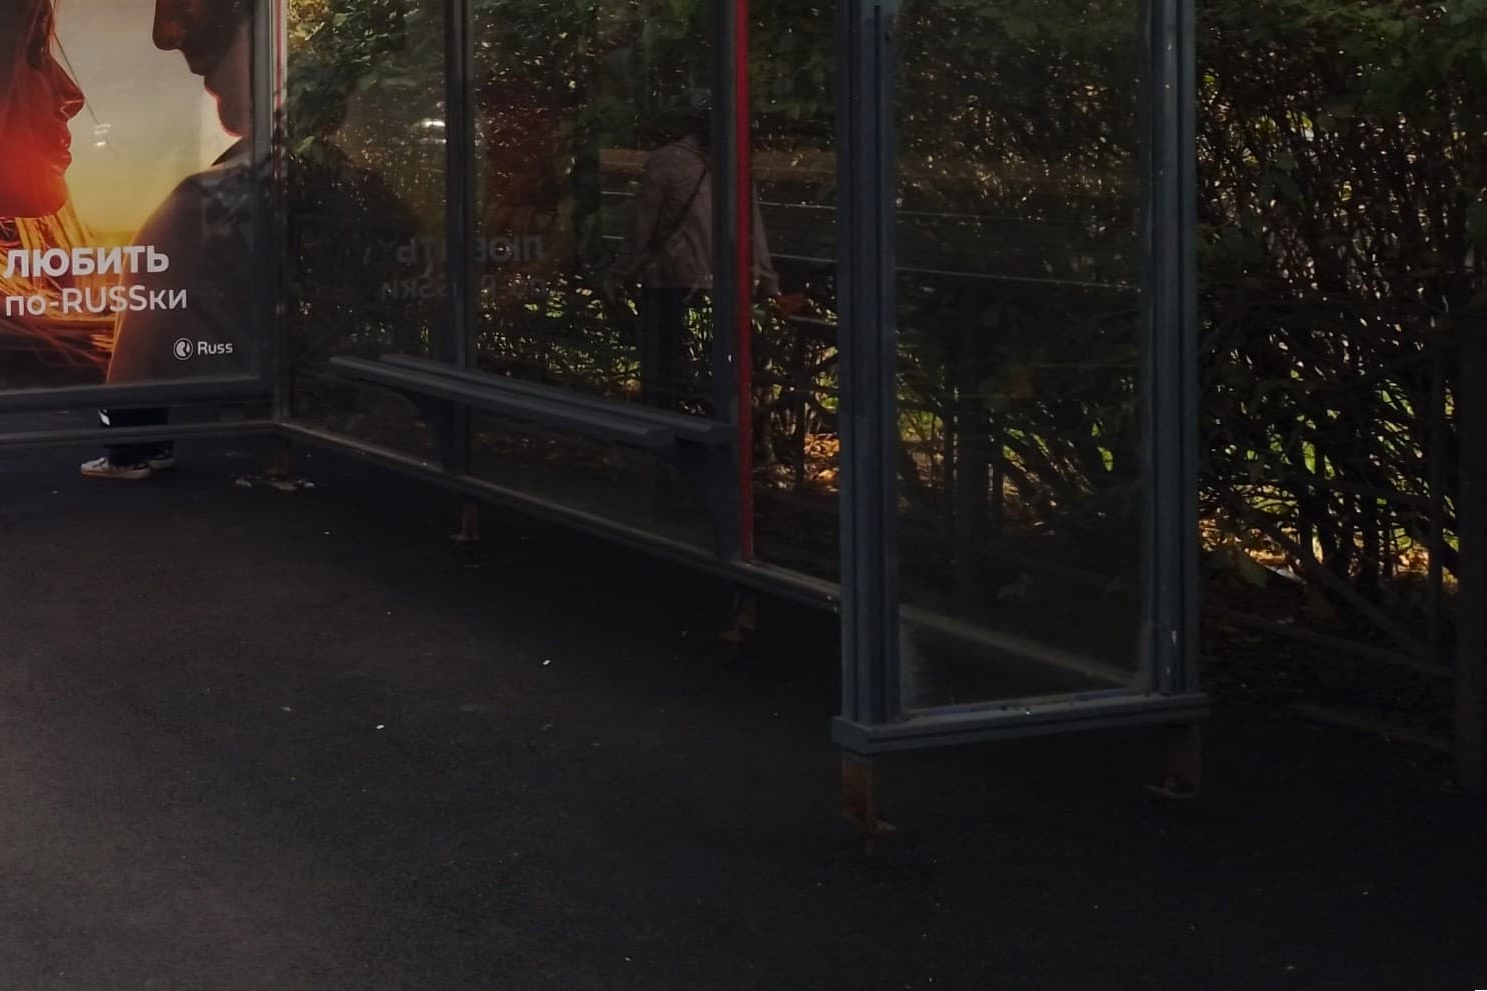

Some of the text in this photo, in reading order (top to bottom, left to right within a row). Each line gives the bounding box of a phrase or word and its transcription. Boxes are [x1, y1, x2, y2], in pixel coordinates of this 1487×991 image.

[3, 245, 170, 279] ЛЮБИТЬ
[5, 285, 188, 317] по-RUSSки
[197, 340, 234, 356] Russ
